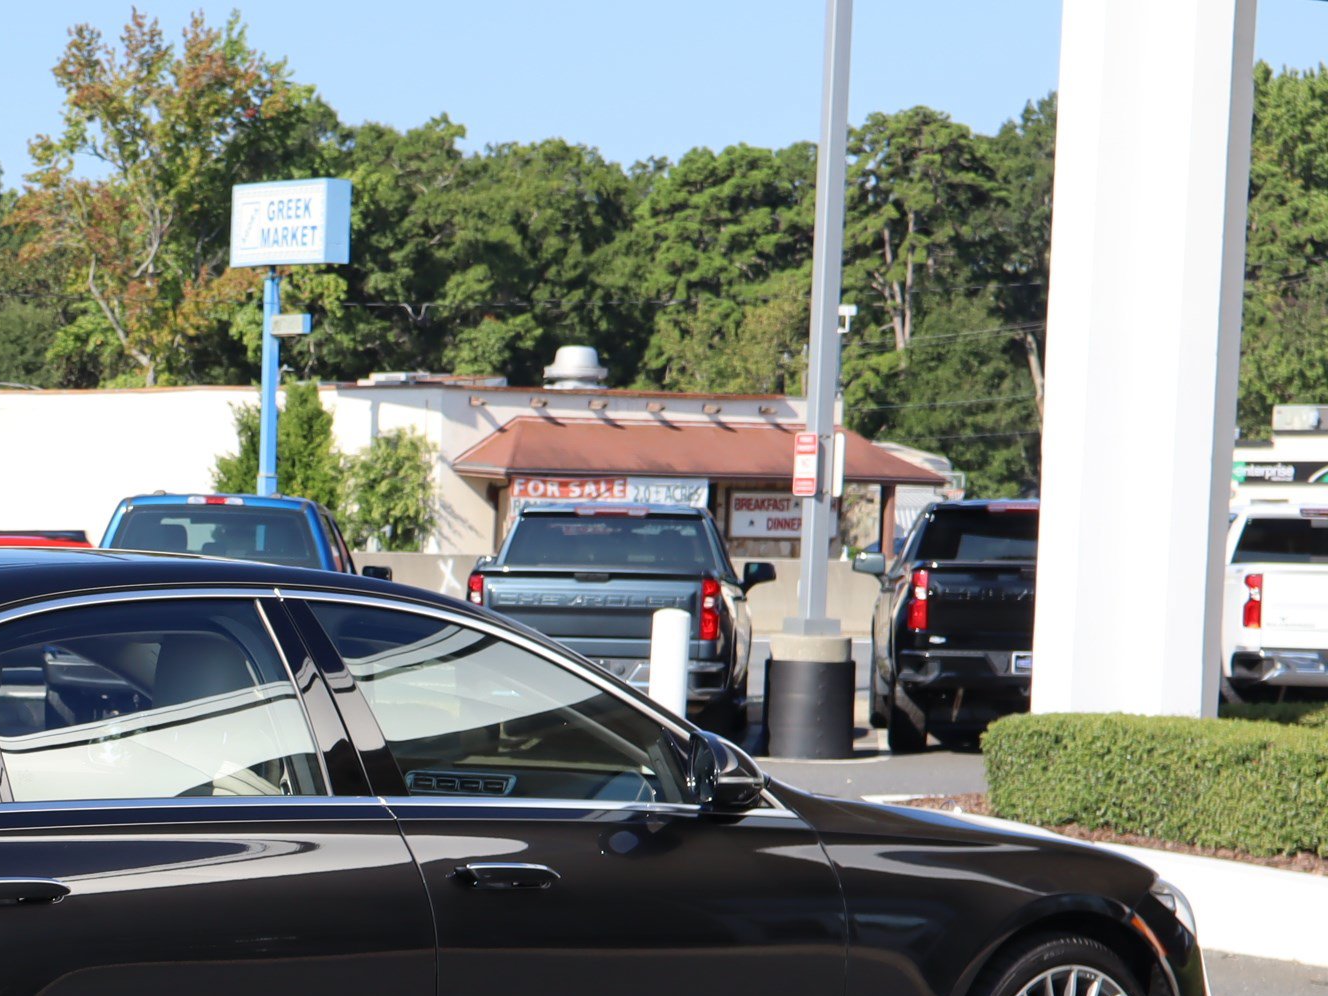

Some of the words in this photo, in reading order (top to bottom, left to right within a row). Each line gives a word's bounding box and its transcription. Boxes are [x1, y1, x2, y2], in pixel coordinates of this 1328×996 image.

[267, 198, 312, 221] GREEK
[260, 225, 318, 248] MARKET
[513, 478, 560, 498] FOR
[569, 479, 625, 498] SALE
[734, 497, 791, 512] BREAKFAST
